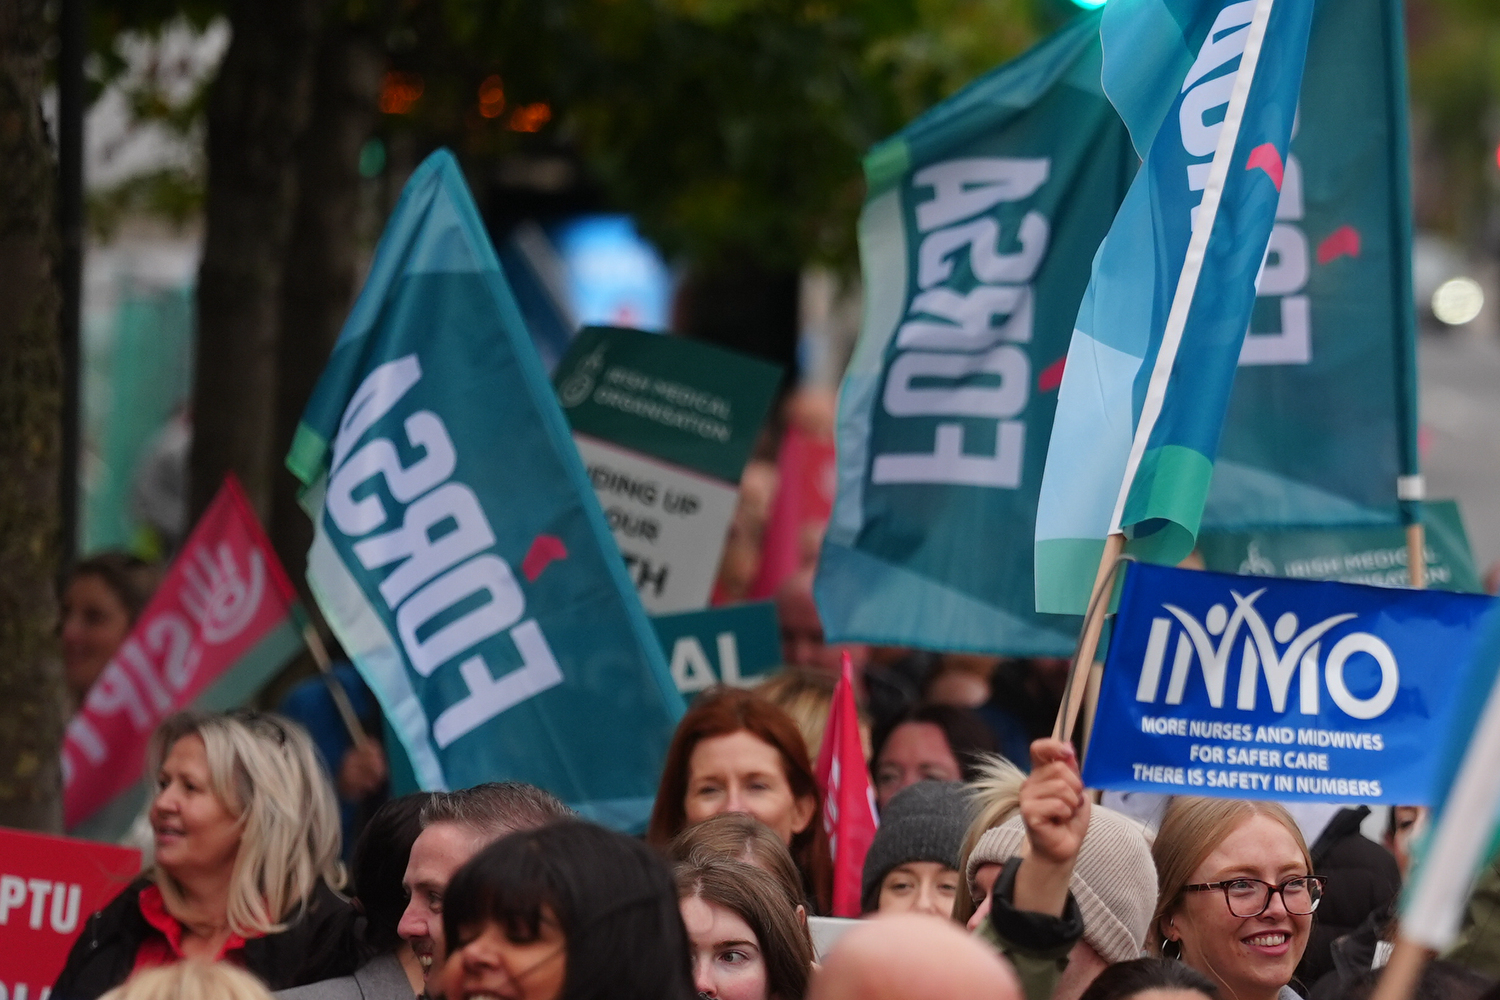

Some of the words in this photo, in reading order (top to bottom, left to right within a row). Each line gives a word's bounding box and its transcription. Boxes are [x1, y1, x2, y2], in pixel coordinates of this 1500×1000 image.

[662, 488, 701, 516] UP
[1135, 587, 1400, 720] INMO
[1141, 716, 1187, 736] MORE
[1189, 720, 1252, 742] NURSES
[1255, 725, 1294, 745] AND
[1297, 728, 1384, 751] MIDWIVES
[1190, 744, 1225, 764] FOR
[1226, 747, 1281, 768] SAFER
[1283, 751, 1329, 771] CARE
[1132, 763, 1183, 784] THERE
[1187, 769, 1203, 786] IS
[1206, 770, 1272, 791] SAFETY
[1274, 775, 1293, 793] IN
[1296, 777, 1383, 797] NUMBERS
